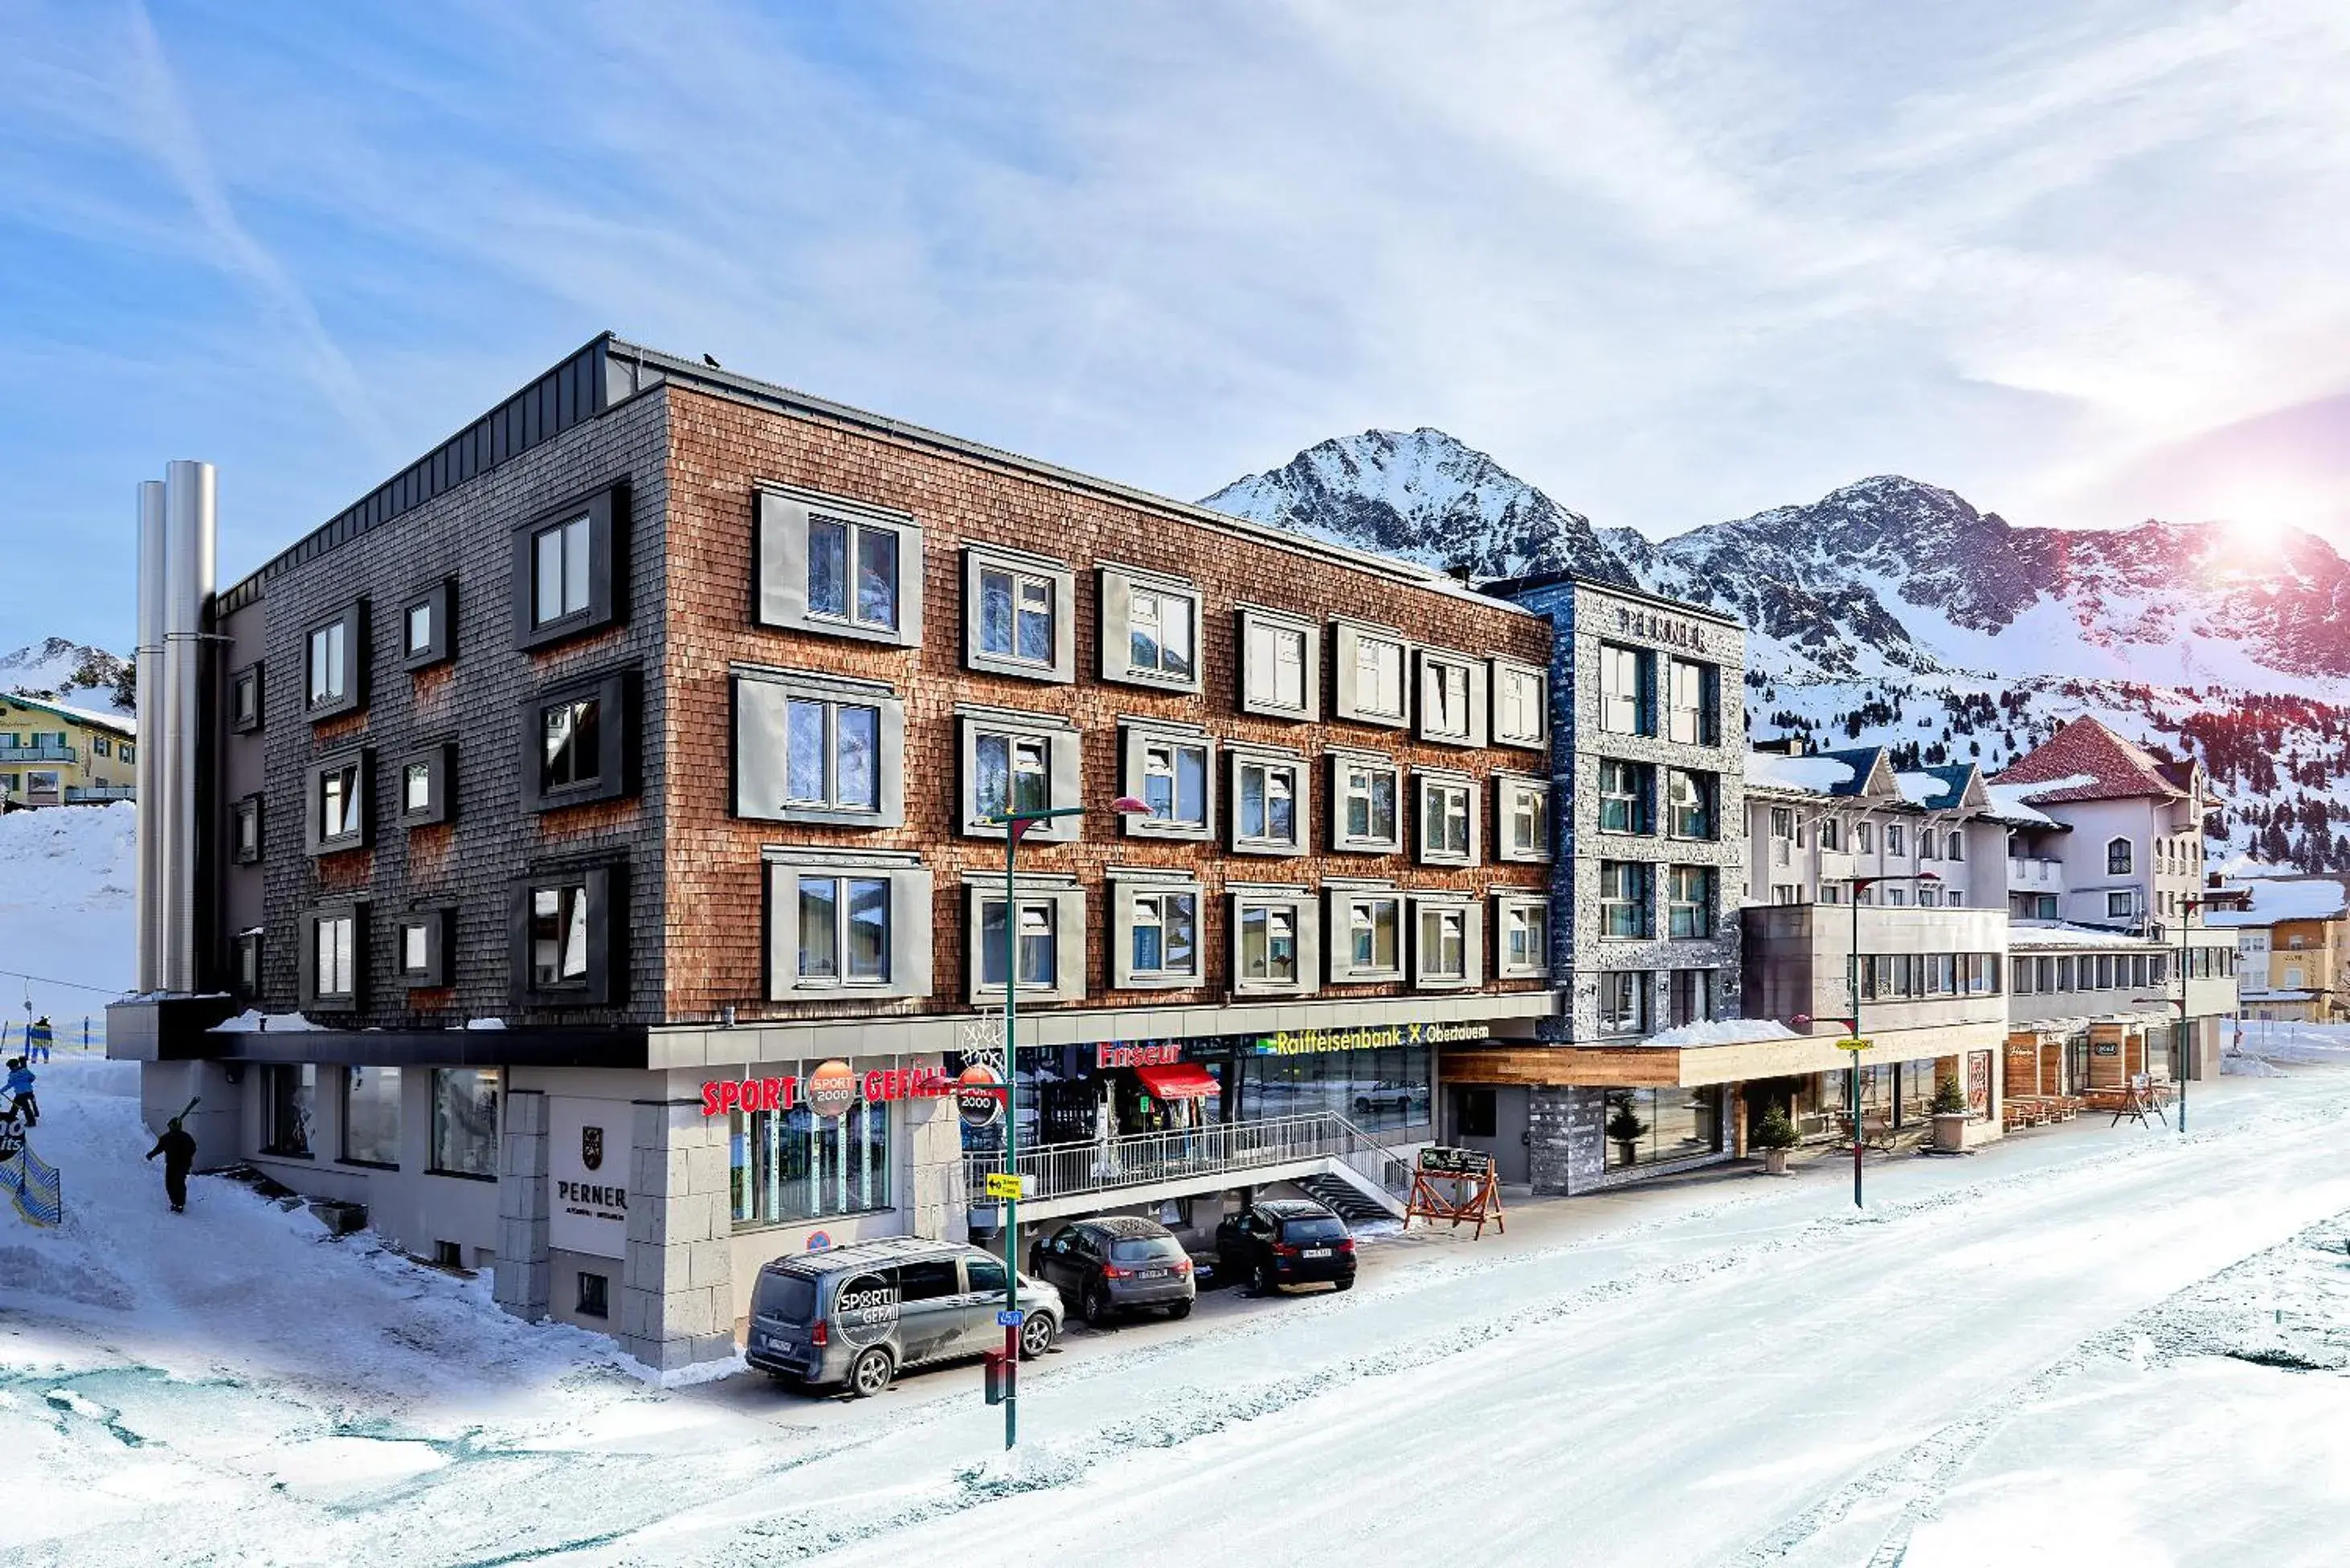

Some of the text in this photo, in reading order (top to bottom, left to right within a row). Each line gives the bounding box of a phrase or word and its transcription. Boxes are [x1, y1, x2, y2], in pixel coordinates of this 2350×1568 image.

[1277, 1024, 1490, 1055] Raiffeisenbank Obertauern
[1096, 1042, 1182, 1069] Friseur
[814, 1077, 852, 1091] SPORT
[817, 1090, 848, 1102] 2000
[701, 1076, 796, 1117] SPORT
[962, 1096, 991, 1109] 2000
[558, 1181, 628, 1210] PERNER
[840, 1288, 889, 1310] SPORT
